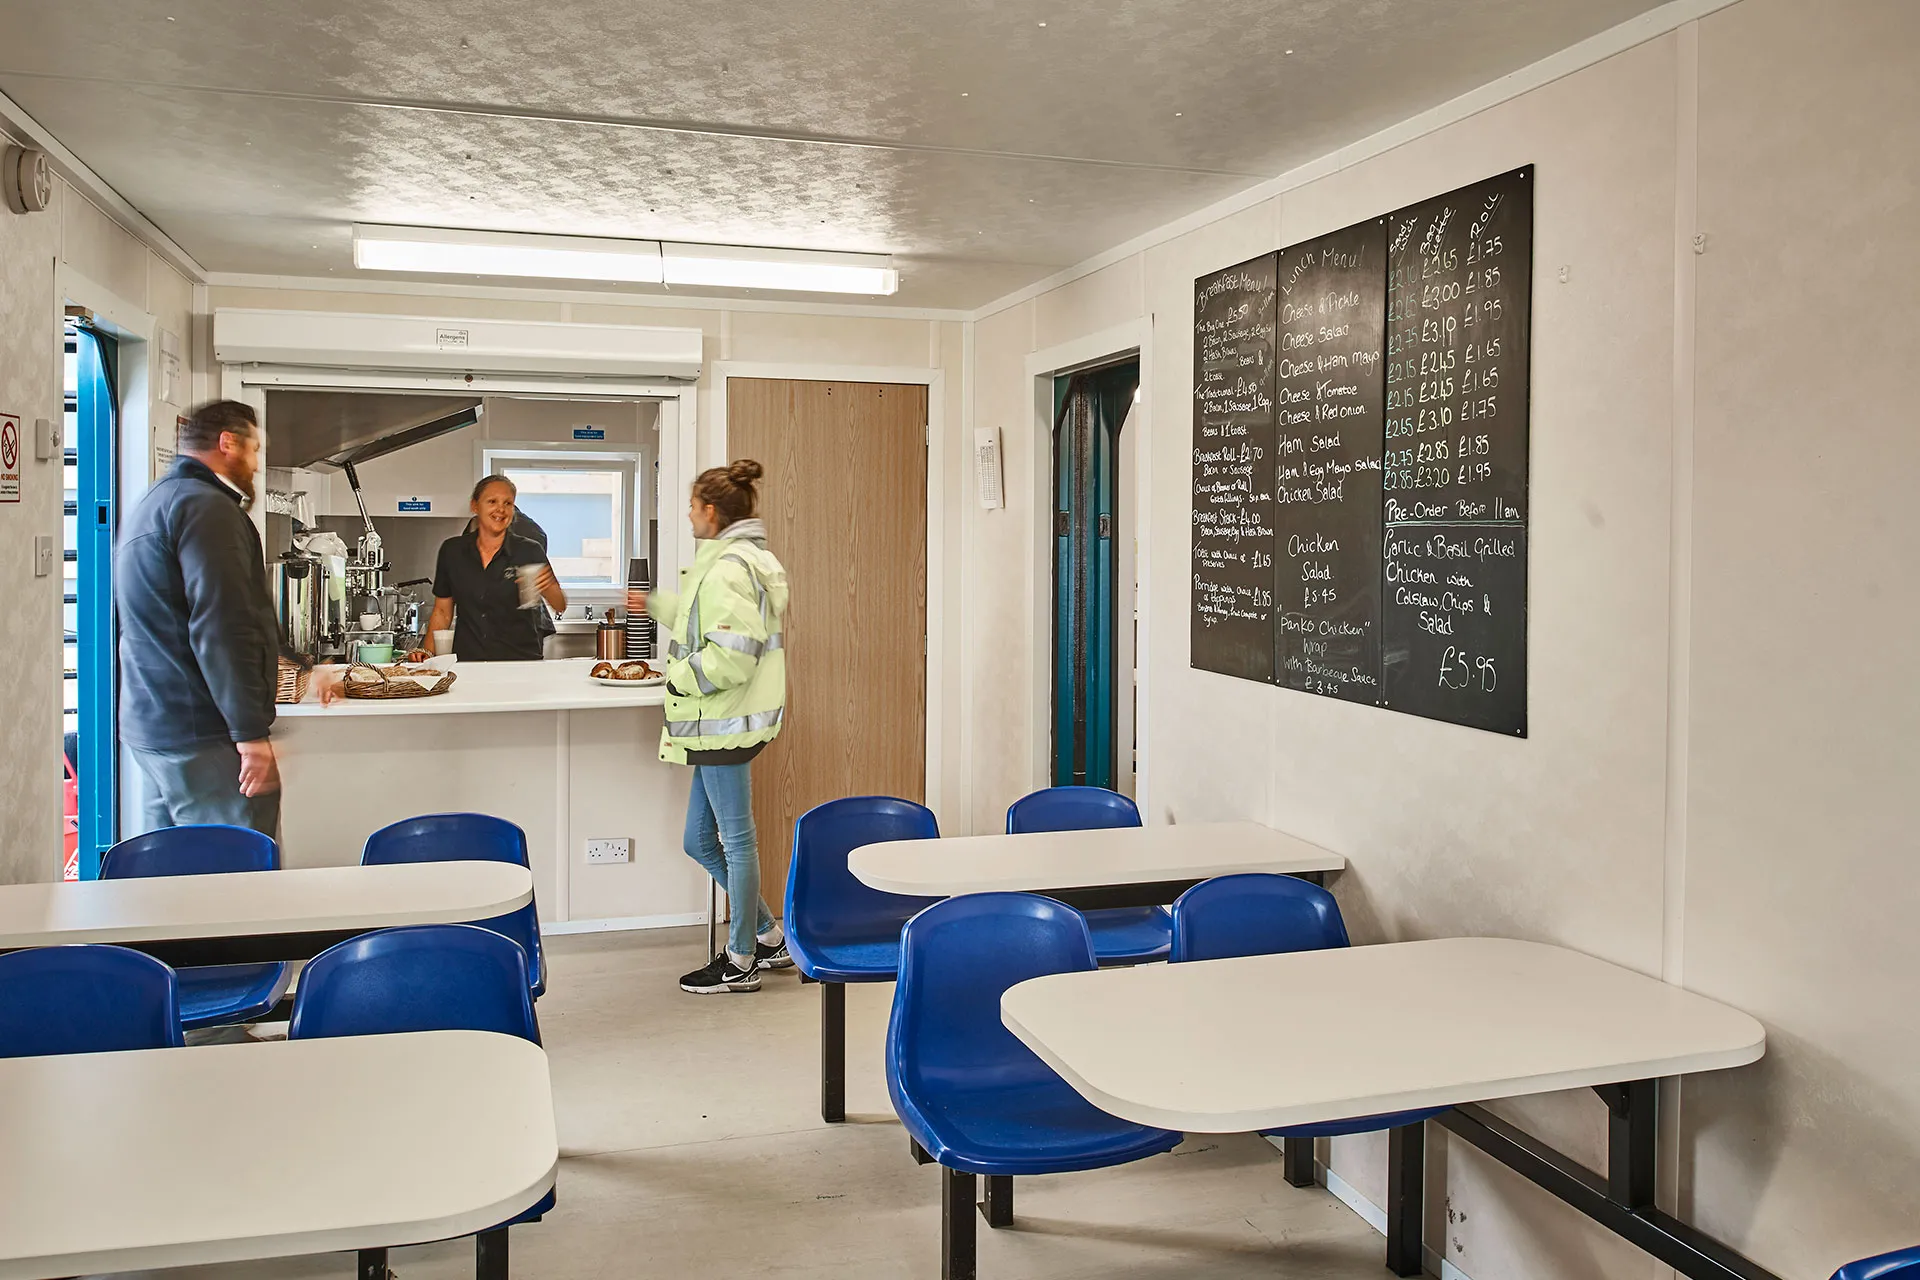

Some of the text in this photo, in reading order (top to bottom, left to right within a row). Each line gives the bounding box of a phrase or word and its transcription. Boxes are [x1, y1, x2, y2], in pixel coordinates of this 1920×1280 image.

[1282, 244, 1365, 296] Lunch Menu!
[1421, 248, 1458, 280] £2.65
[1466, 236, 1503, 266] £1.75
[1196, 273, 1239, 312] Breakfast
[1421, 281, 1461, 310] £3.00
[1465, 266, 1501, 294] £1.85
[1282, 291, 1360, 325] Cheese & Pickle
[1464, 299, 1502, 328] £1.95
[1282, 323, 1350, 352] Cheese Salad
[1279, 358, 1314, 379] Cheese
[1324, 355, 1348, 372] Ham
[1387, 358, 1417, 384] £2.15
[1465, 338, 1501, 364] £1.65
[1279, 387, 1311, 405] Cheese
[1387, 387, 1414, 410] £2.15
[1462, 366, 1499, 395] £1.65
[1279, 409, 1311, 426] Cheese
[1315, 405, 1322, 424] &
[1322, 403, 1338, 420] Red
[1416, 406, 1452, 433] £3.10
[1461, 395, 1497, 421] £1.75
[1193, 447, 1221, 466] Breakfast
[1278, 430, 1341, 457] Ham Salad
[1458, 434, 1490, 458] £1.85
[1278, 465, 1300, 487] Ham
[1302, 461, 1310, 478] &
[1309, 464, 1325, 484] Egg
[1326, 459, 1352, 483] Mayo
[1457, 461, 1492, 485] £1.95
[1277, 480, 1343, 505] Chicken Salad
[1455, 499, 1487, 519] Before
[1288, 532, 1340, 558] Chicken
[1384, 528, 1422, 563] Garlic
[1434, 534, 1471, 560] Basil
[1386, 560, 1474, 588] Chicken with
[1442, 591, 1474, 615] Chips
[1483, 593, 1492, 616] &
[1417, 610, 1454, 636] Salad
[1350, 666, 1377, 686] Sauce
[1438, 645, 1497, 692] £5.95
